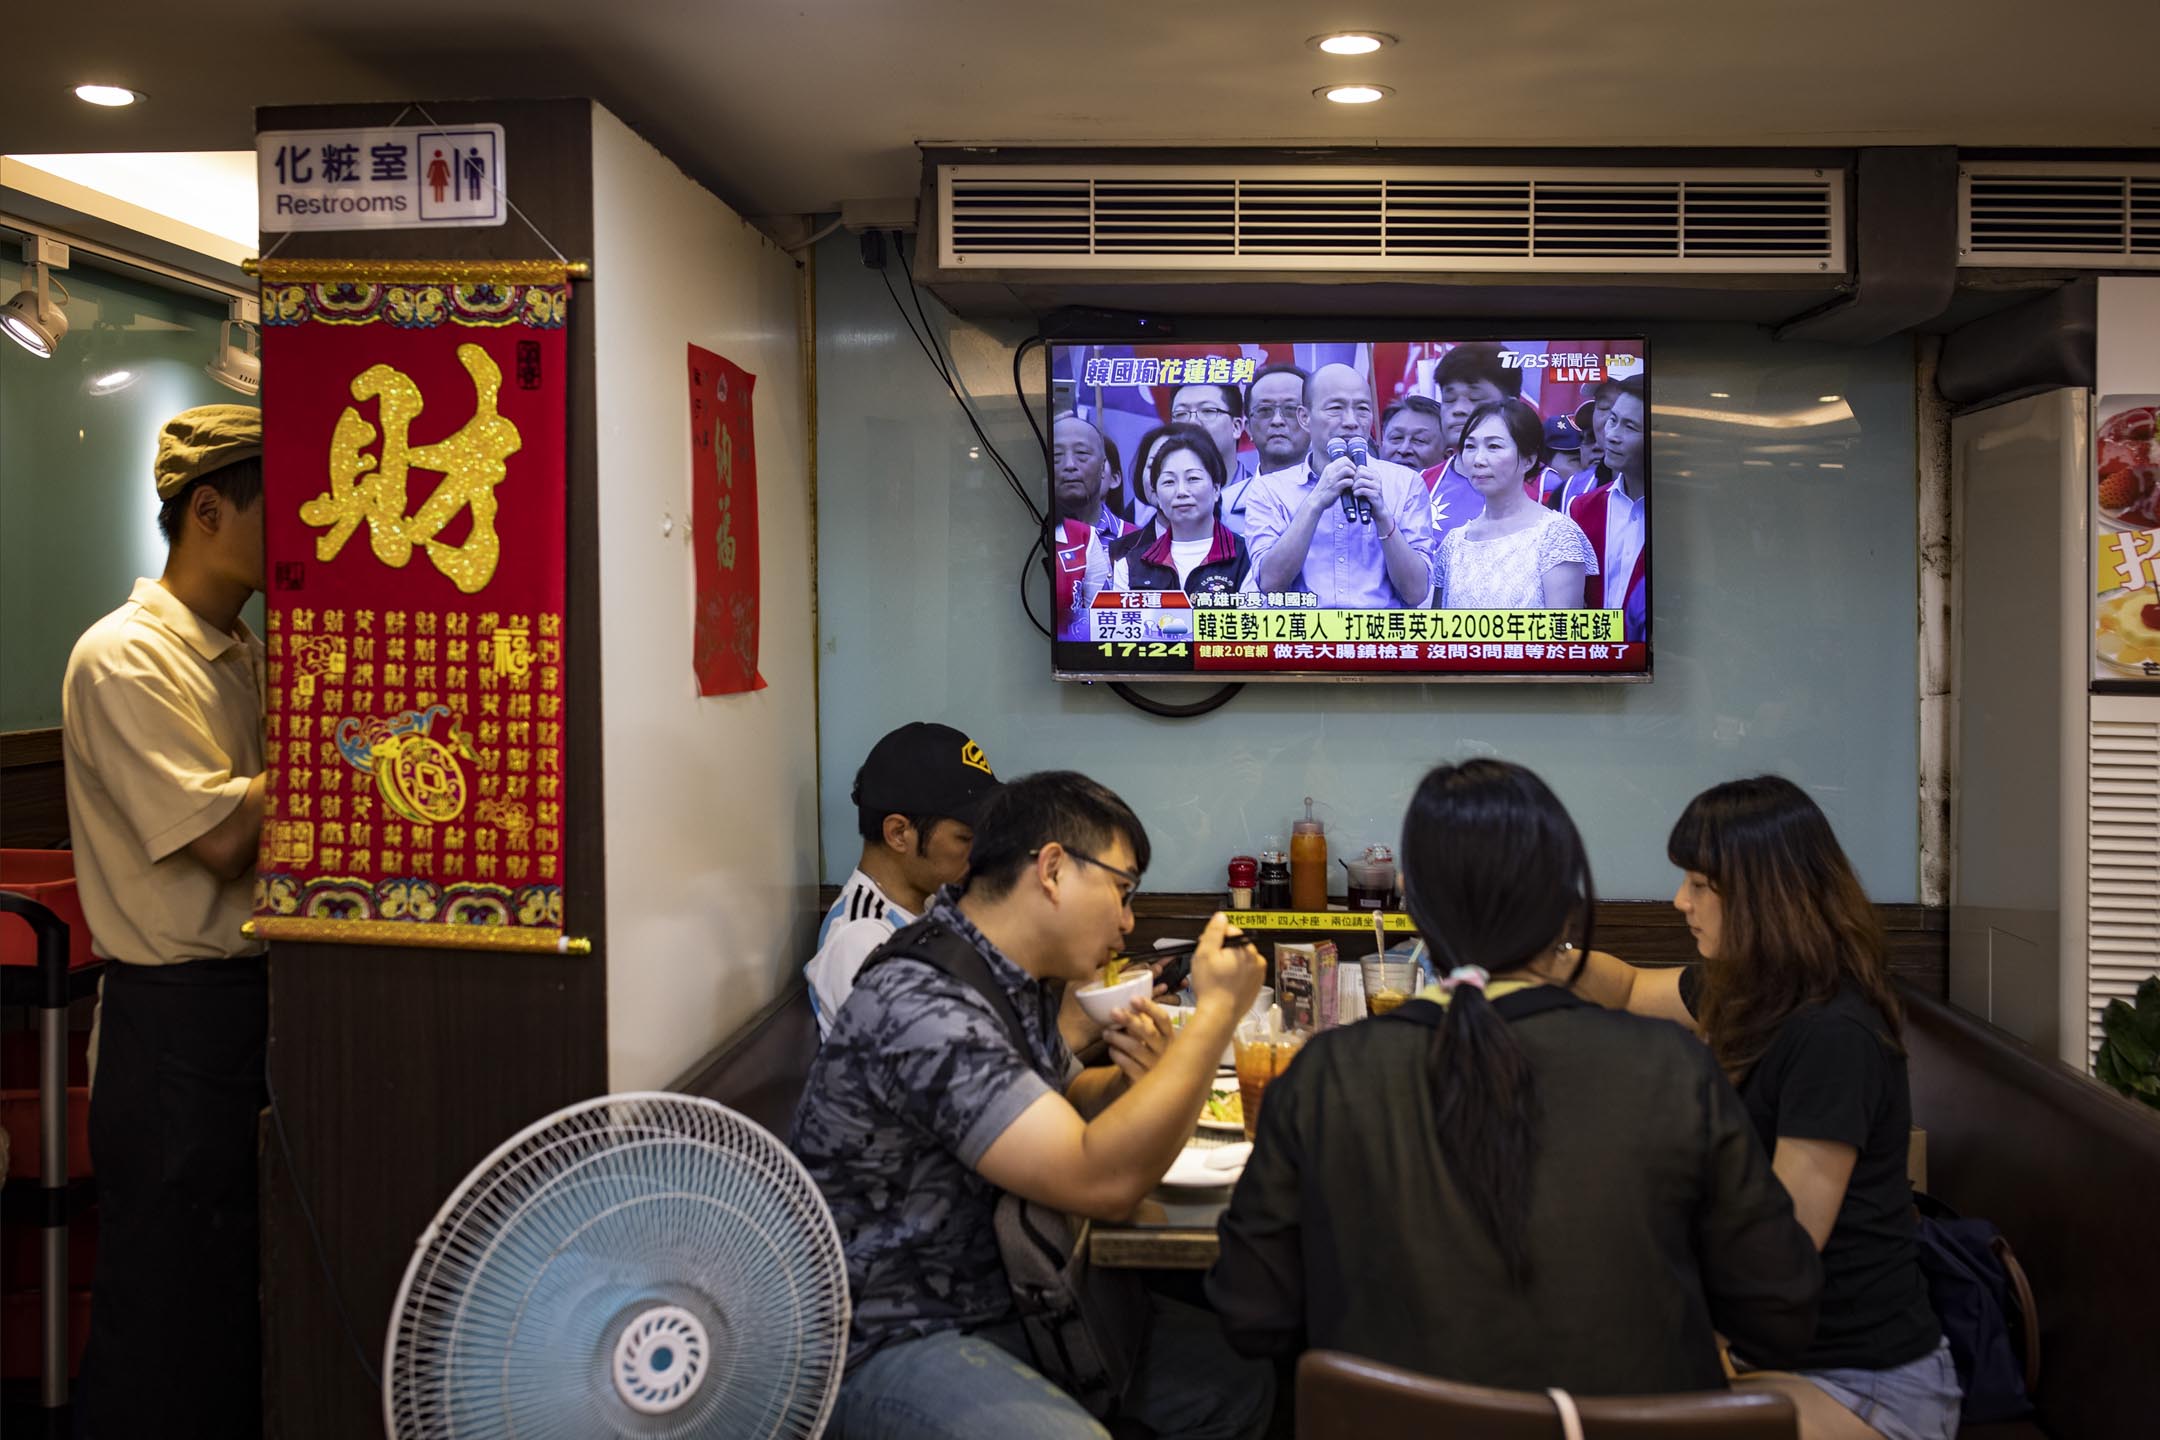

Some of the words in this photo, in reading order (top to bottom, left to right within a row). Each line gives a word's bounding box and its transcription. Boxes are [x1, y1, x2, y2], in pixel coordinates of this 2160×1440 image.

[275, 142, 408, 184] 化粧室
[276, 194, 408, 215] Restrooms
[1497, 352, 1549, 368] TVBS
[1551, 353, 1599, 367] 新聞台
[1605, 354, 1636, 367] HD
[1085, 358, 1257, 386] 韓國瑜花蓮造勢
[1556, 368, 1601, 382] LIVE
[1119, 592, 1162, 608] 花蓮
[1196, 592, 1262, 607] 高雄市長
[1267, 592, 1318, 607] 韓國瑜
[1096, 611, 1142, 625] 苗栗
[1099, 626, 1142, 639] 27~33
[1198, 612, 1328, 641] 韓造勢12萬人
[1098, 642, 1188, 657] 17:24
[1199, 644, 1269, 658] 健康2.0官網
[1273, 644, 1419, 659] 做完大腸鏡檢查
[1426, 644, 1630, 660] 沒問3問題等於白做了
